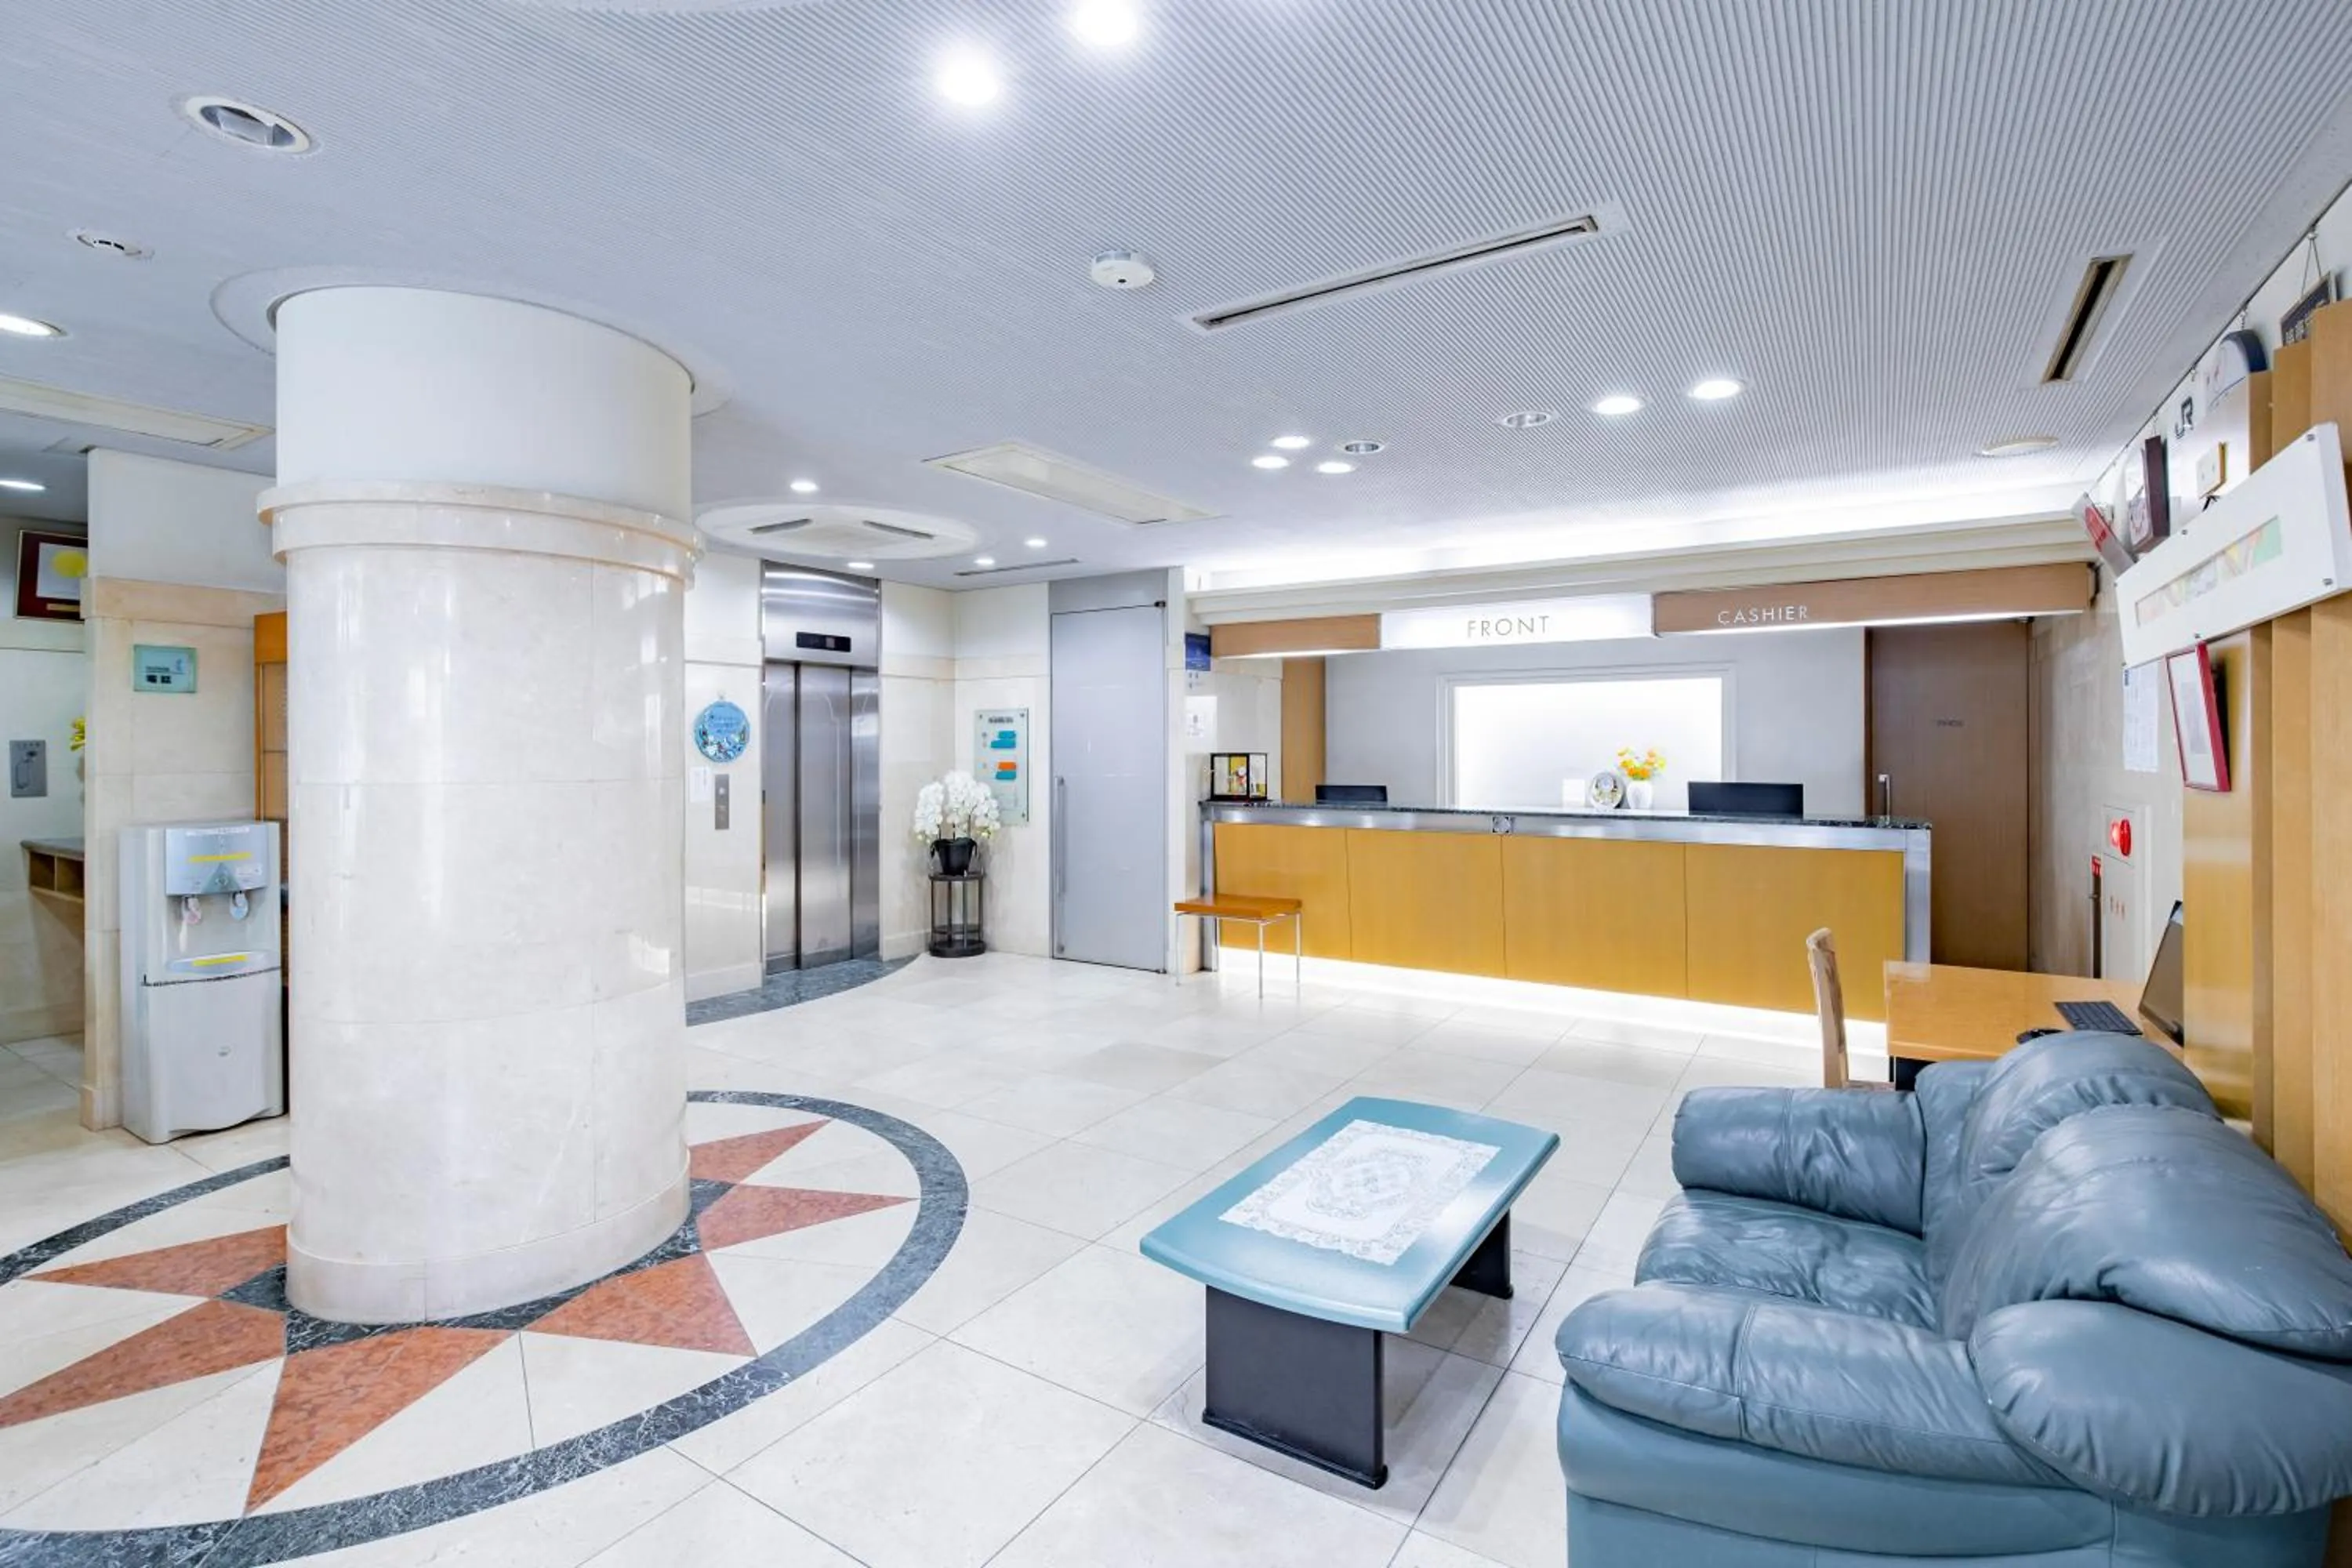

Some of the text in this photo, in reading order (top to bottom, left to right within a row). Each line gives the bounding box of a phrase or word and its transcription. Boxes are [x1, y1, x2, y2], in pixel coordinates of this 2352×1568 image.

[2174, 396, 2193, 440] JR
[1718, 604, 1808, 625] CASHIER
[1467, 615, 1549, 638] FRONT
